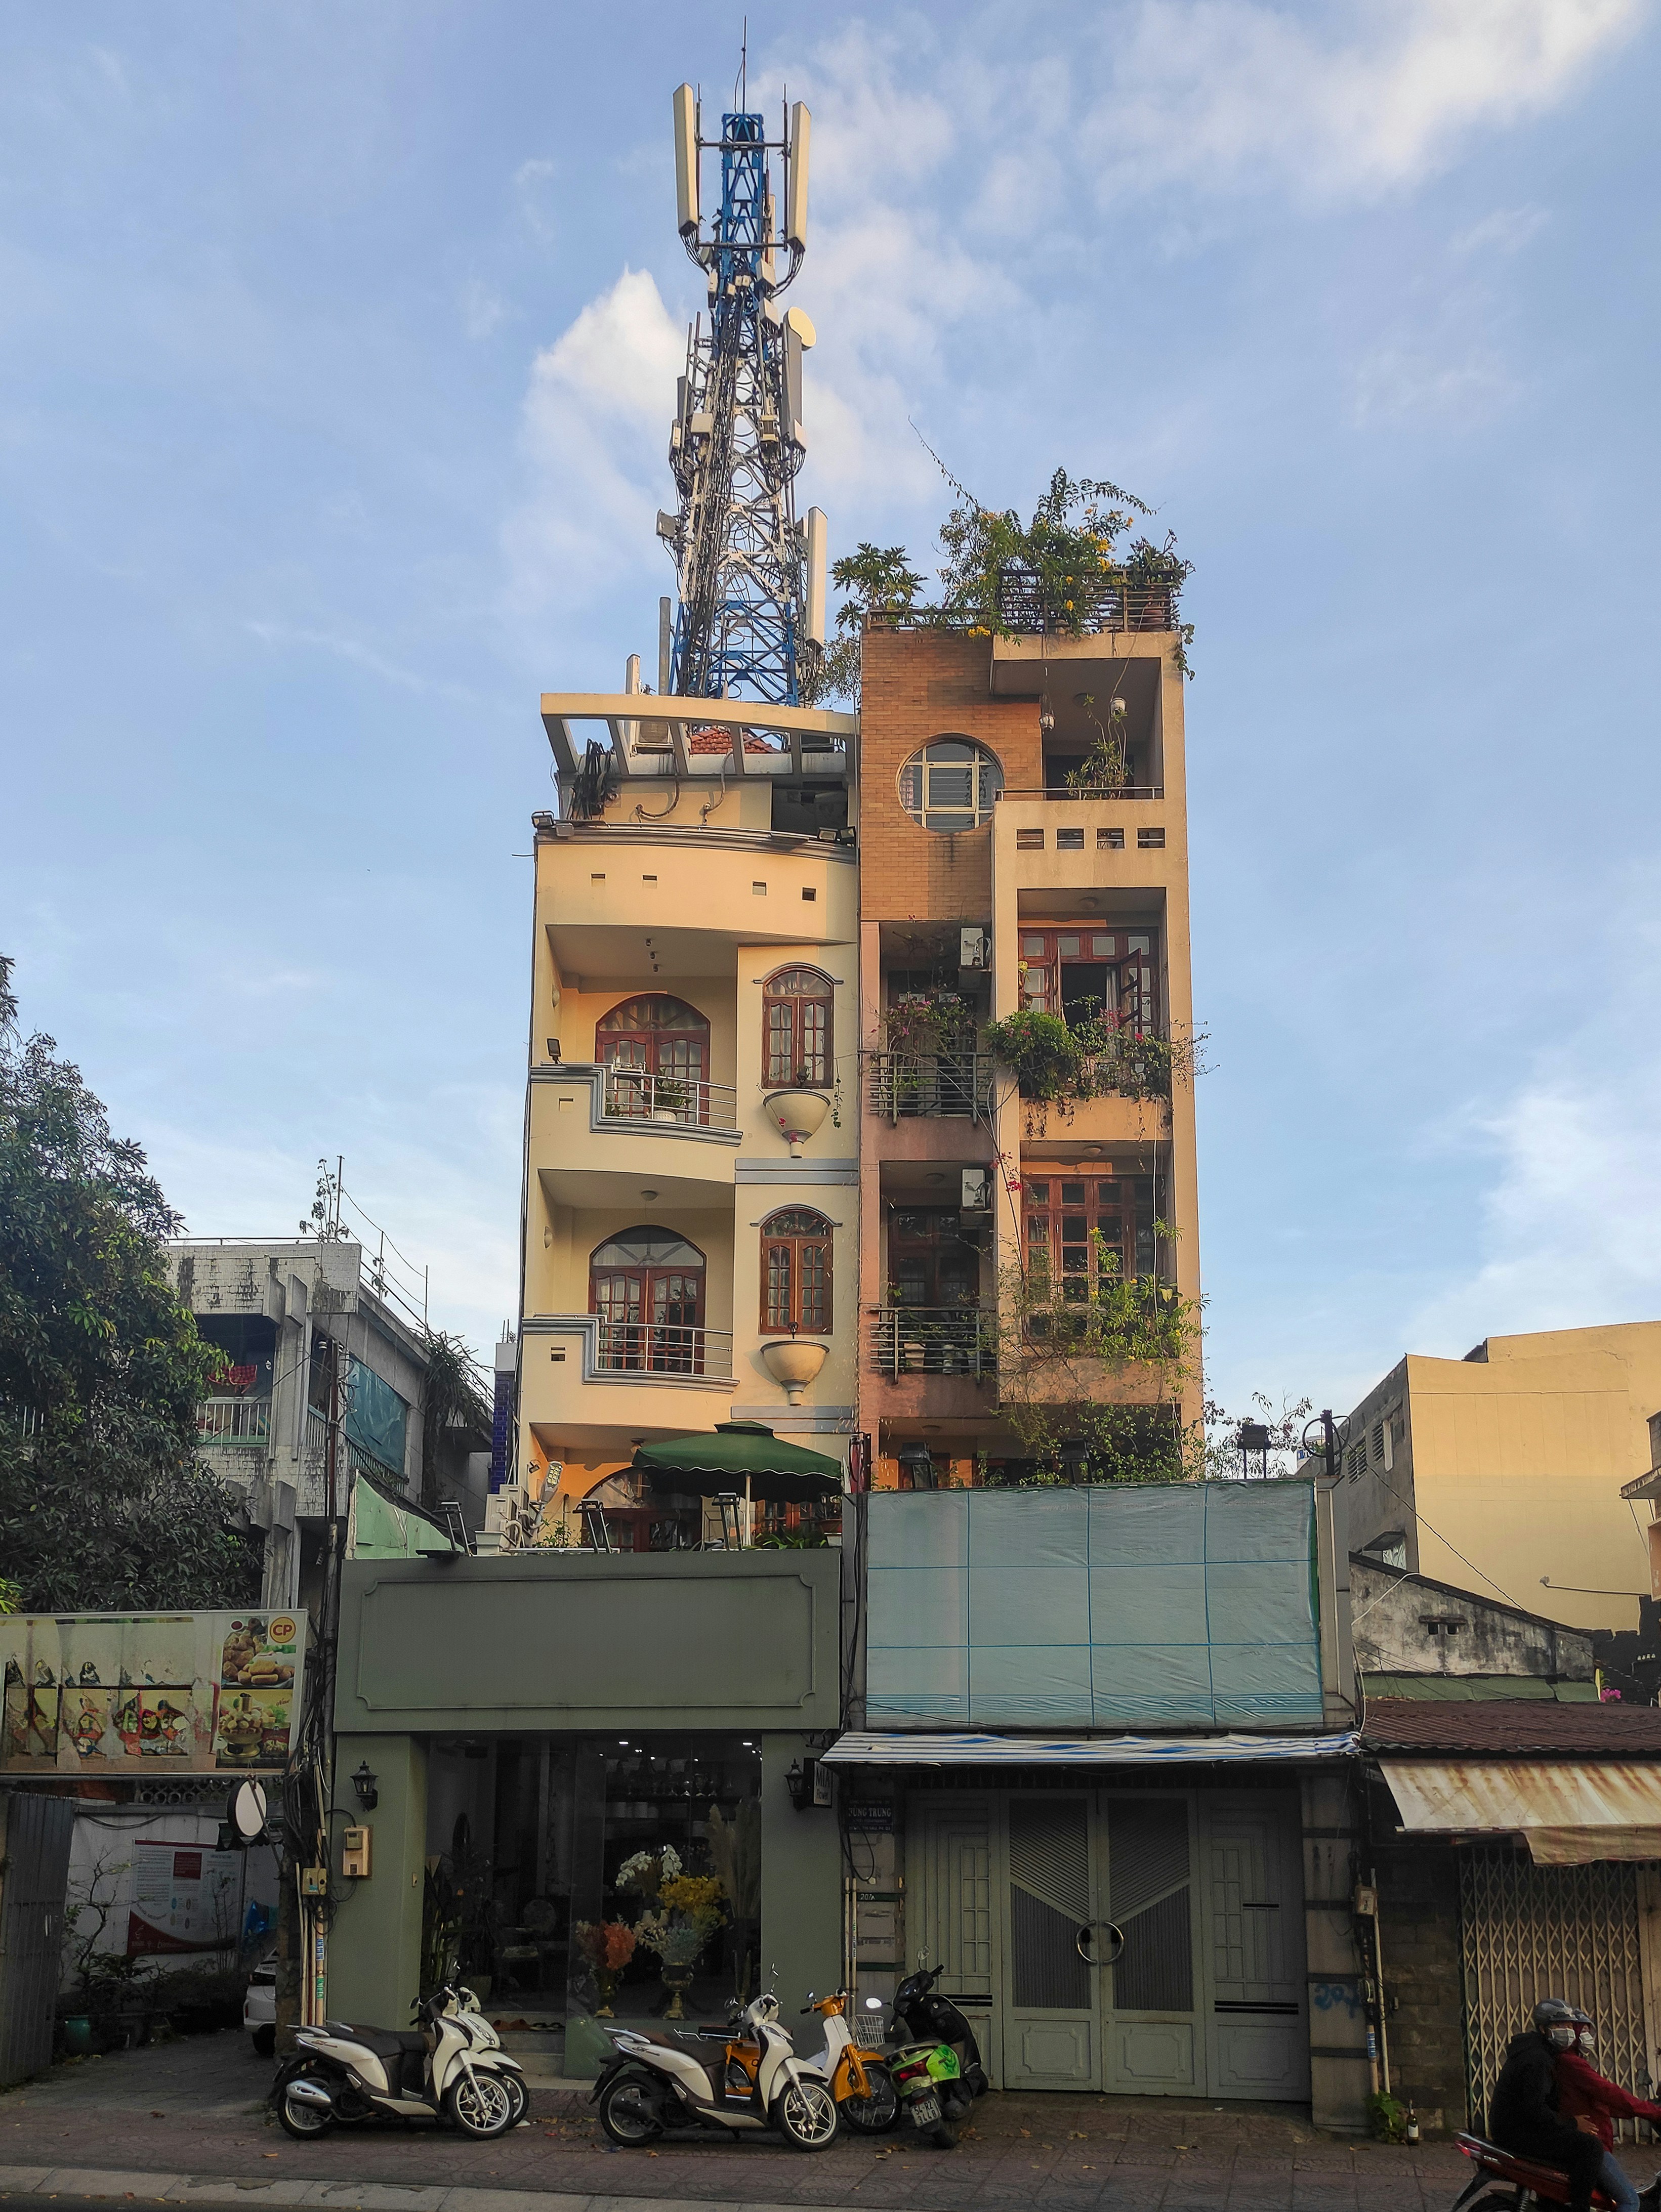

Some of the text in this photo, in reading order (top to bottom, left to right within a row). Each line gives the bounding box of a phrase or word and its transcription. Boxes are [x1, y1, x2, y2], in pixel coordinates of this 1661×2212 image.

[273, 1624, 293, 1636] CP
[816, 1767, 830, 1788] MIA
[868, 1807, 891, 1817] TRUNG
